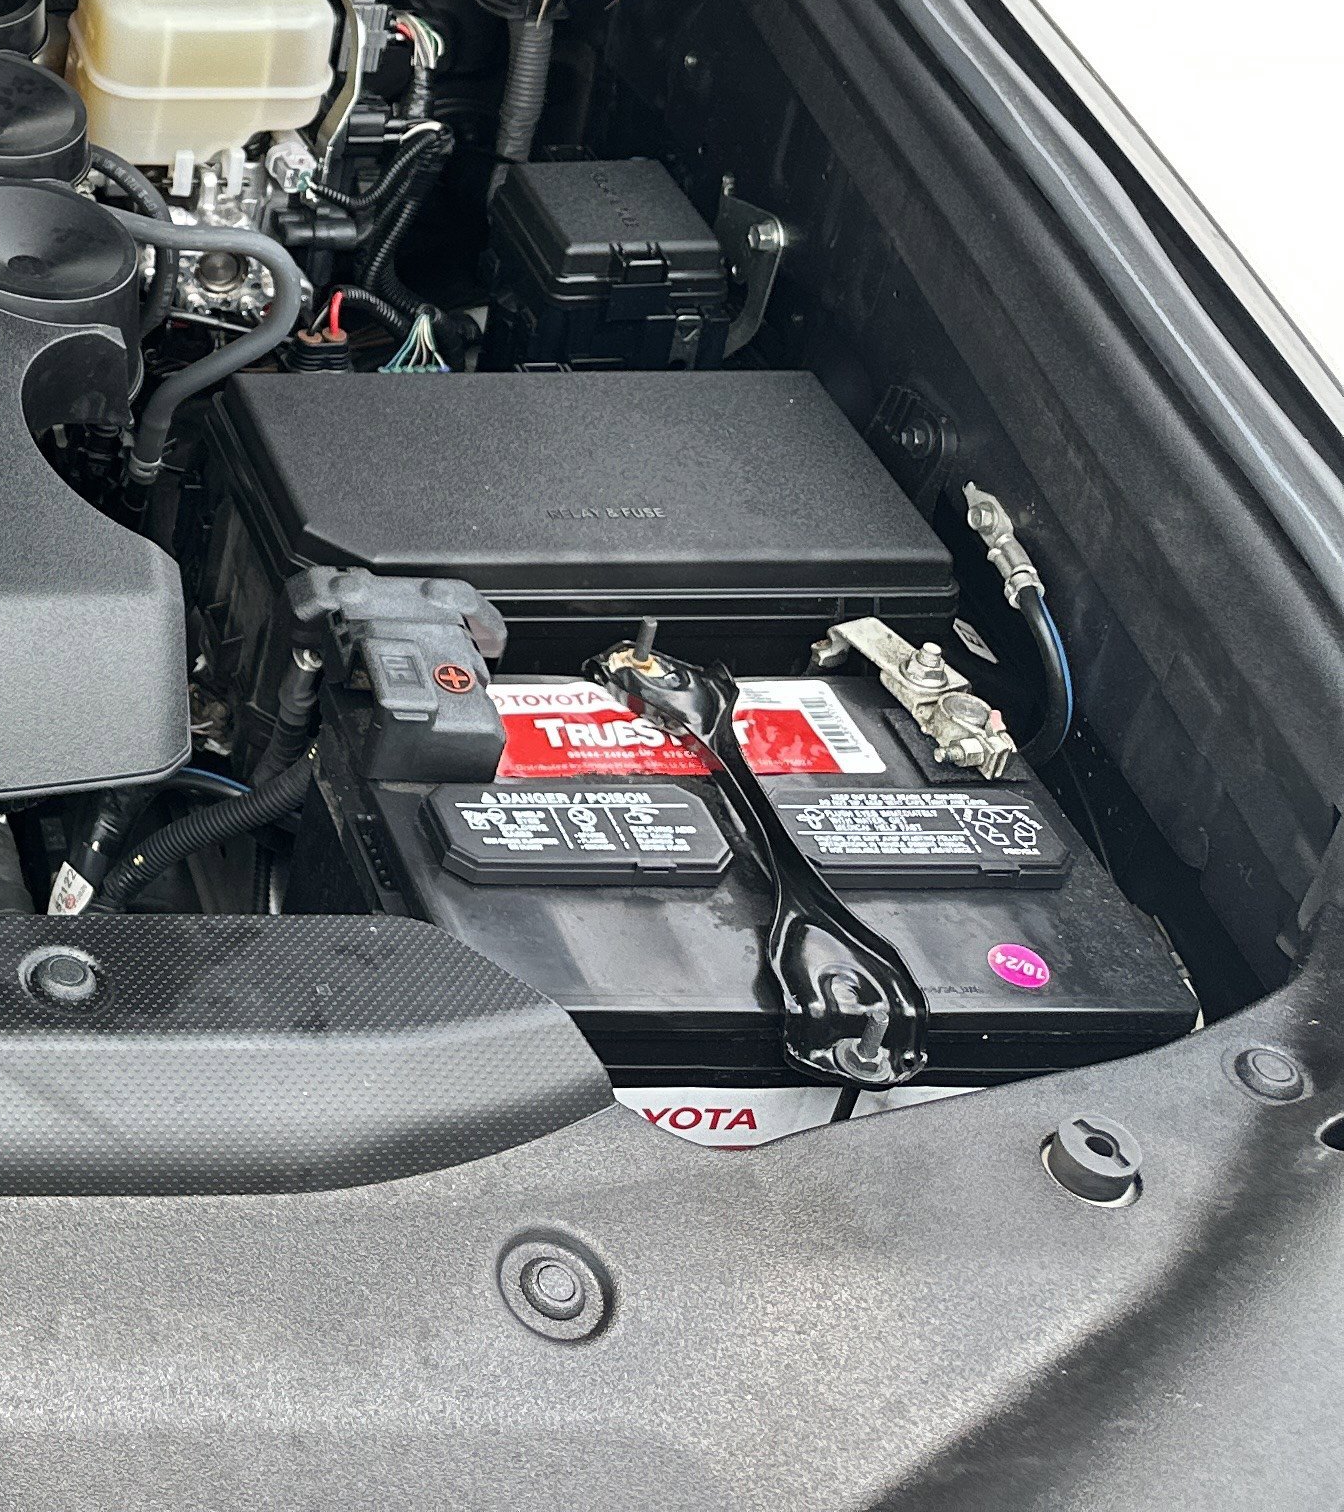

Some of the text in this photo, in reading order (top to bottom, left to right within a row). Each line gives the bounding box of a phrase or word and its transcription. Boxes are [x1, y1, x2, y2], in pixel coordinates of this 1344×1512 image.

[547, 507, 666, 519] RELAY & FUSE
[508, 691, 604, 707] TOYOTA
[496, 792, 571, 804] DANGER
[584, 792, 652, 804] POISON
[993, 951, 1046, 980] 10/24
